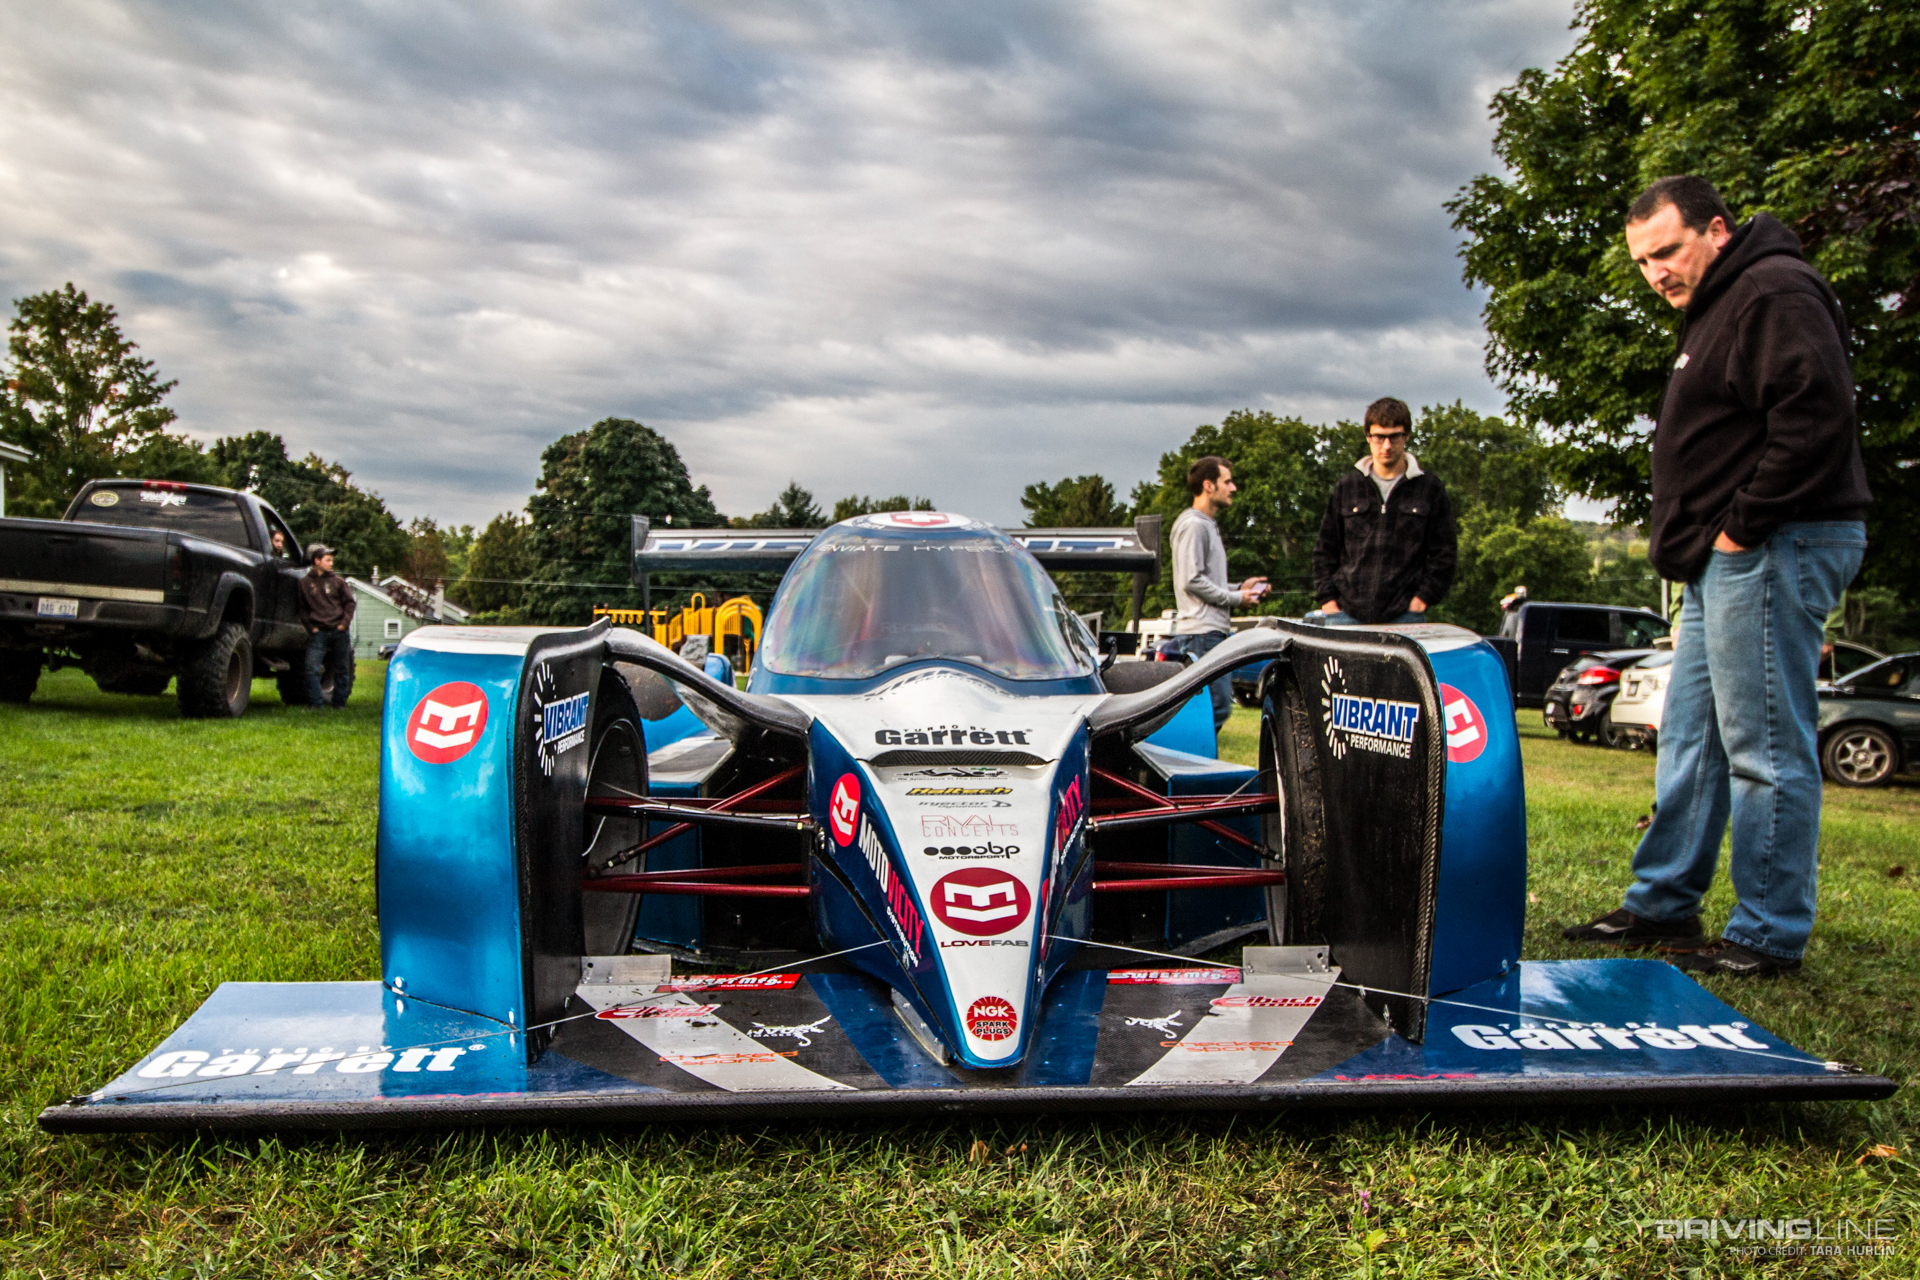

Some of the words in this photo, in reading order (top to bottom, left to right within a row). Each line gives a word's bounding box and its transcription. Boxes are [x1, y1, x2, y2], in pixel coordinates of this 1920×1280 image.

[913, 544, 1009, 553] HYPERC
[544, 691, 589, 744] VIBRANT
[1332, 693, 1420, 743] VIBRANT
[556, 730, 585, 754] PERFORMANCE
[875, 729, 1030, 745] Garrett
[1350, 734, 1411, 759] PERFORMANCE
[906, 787, 1013, 795] Haltech
[921, 815, 1016, 826] RIVAL
[922, 826, 1019, 837] CONCEPTS
[972, 841, 1020, 859] obp
[858, 812, 925, 955] MOTOVICITY
[940, 940, 1030, 948] LOVEFAB
[973, 1005, 1009, 1018] NGK
[1451, 1025, 1768, 1050] Garrett
[137, 1047, 467, 1078] Garrett
